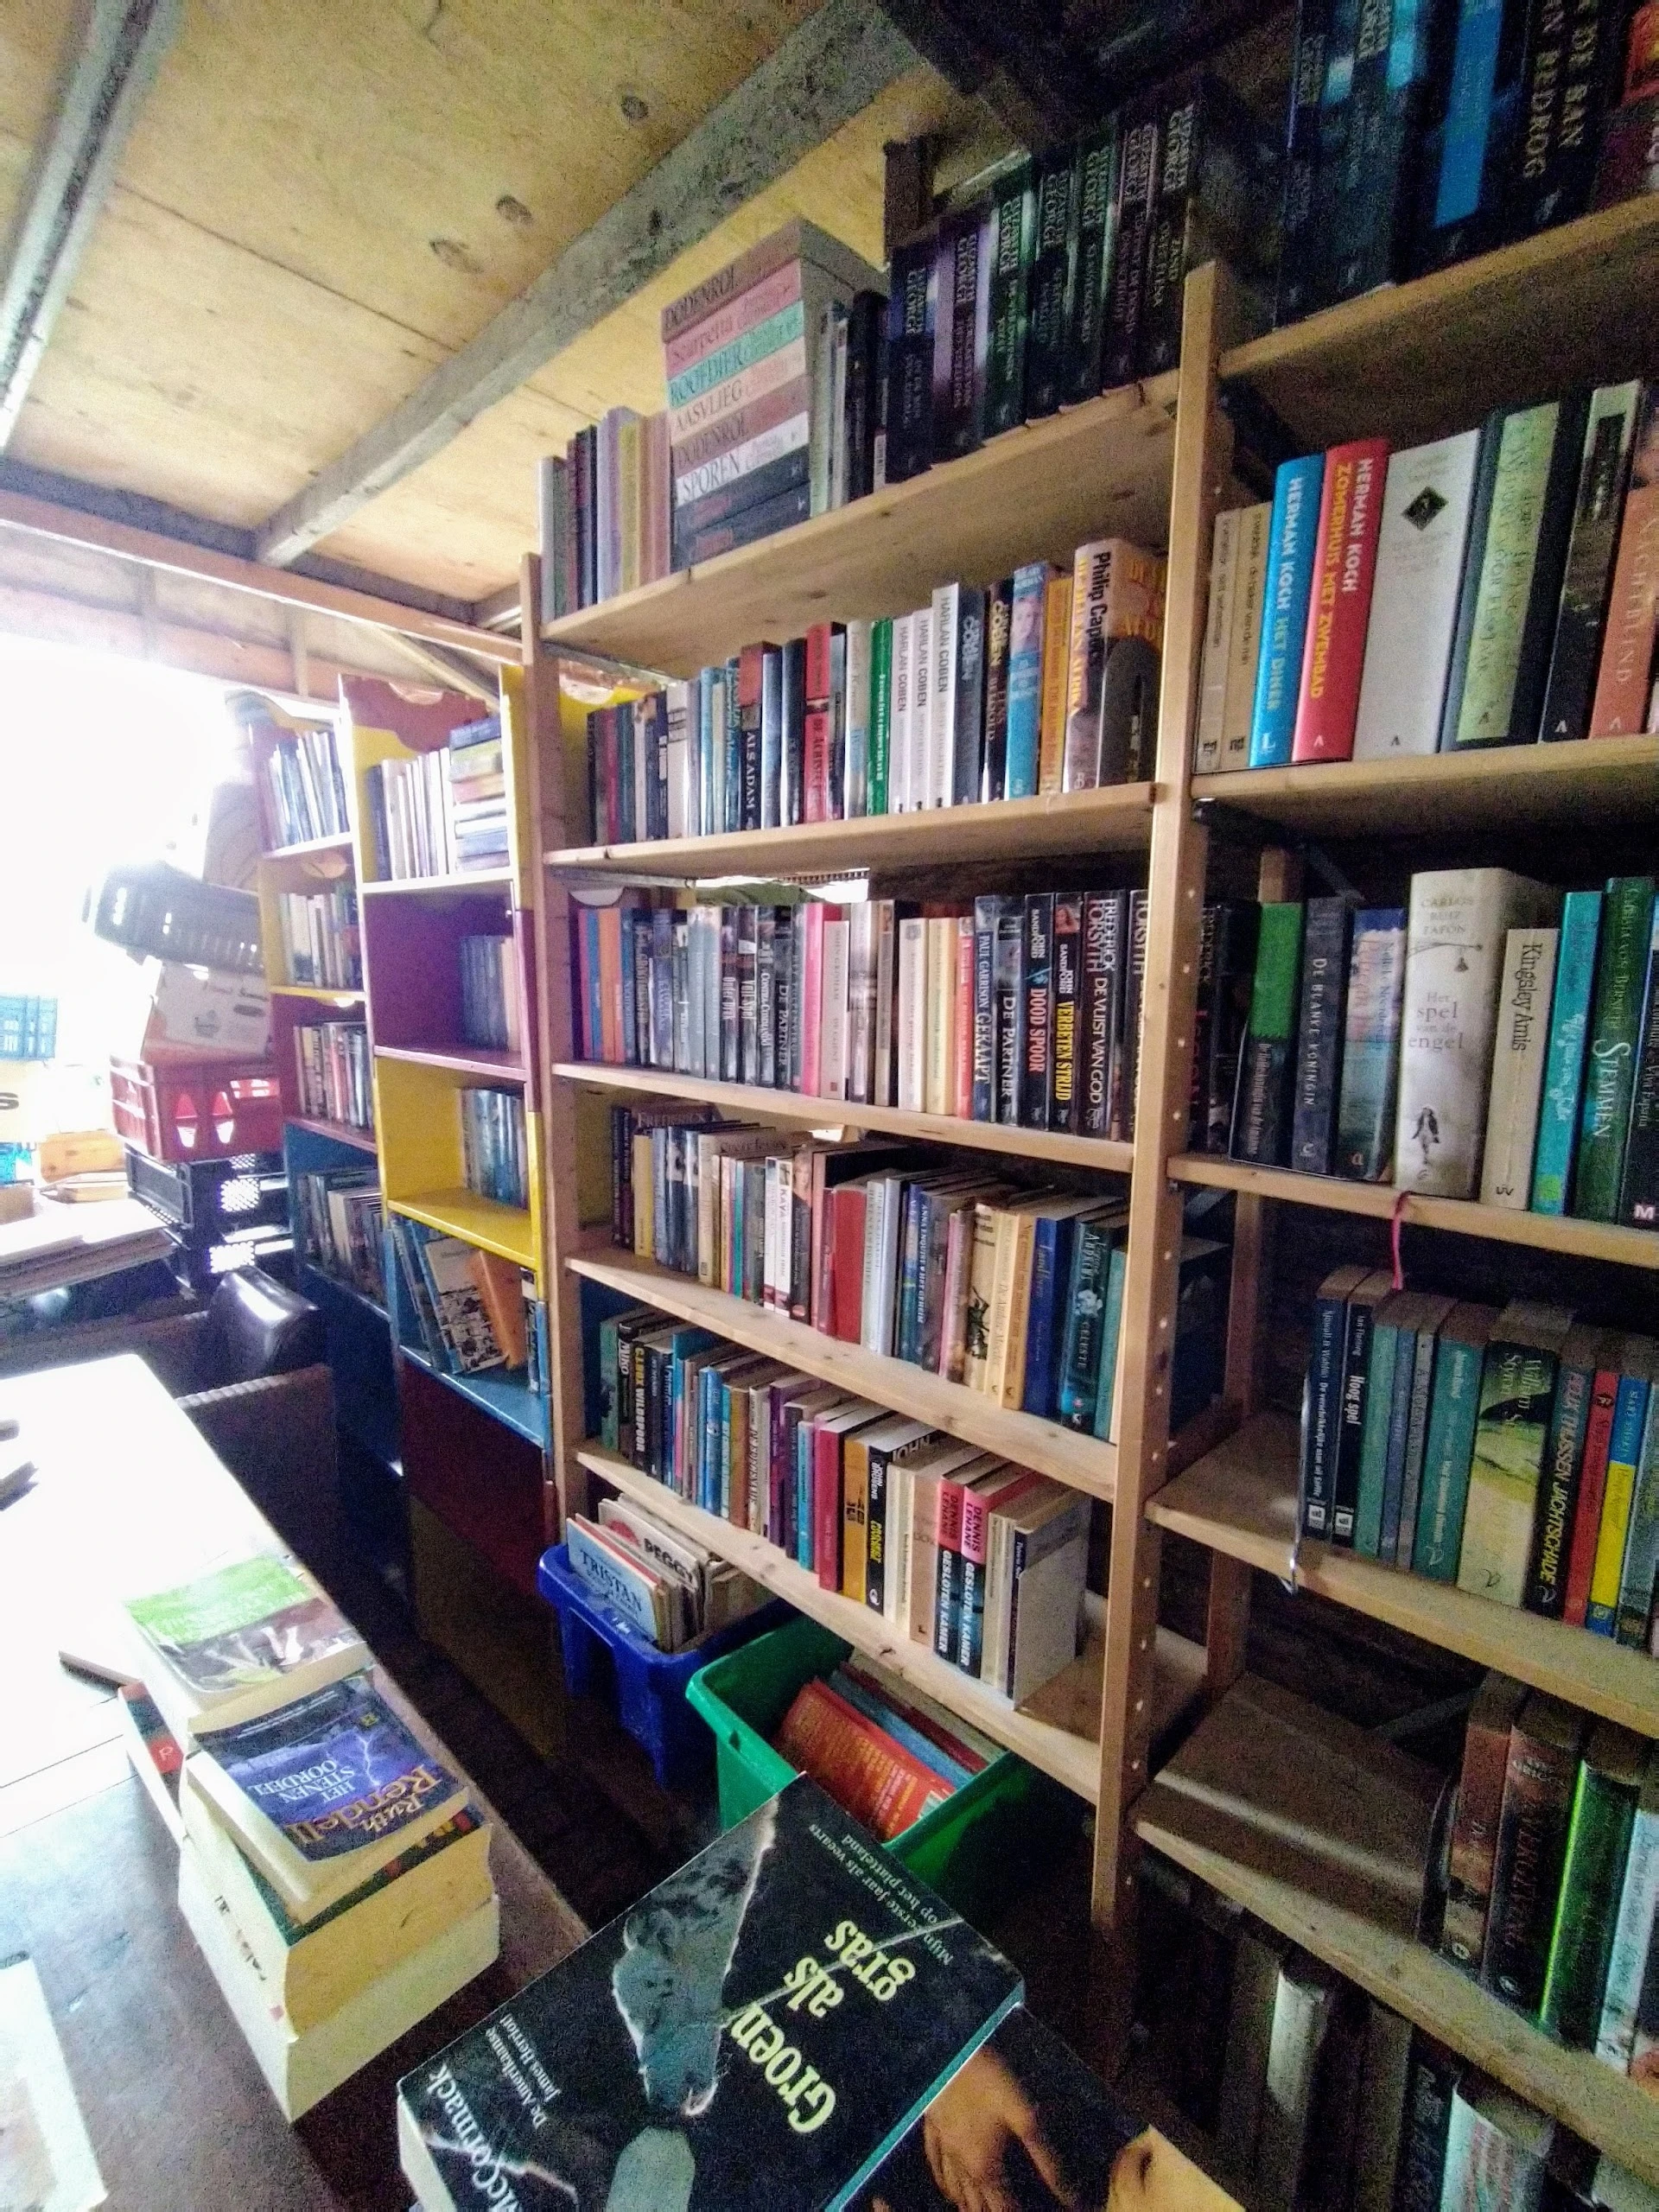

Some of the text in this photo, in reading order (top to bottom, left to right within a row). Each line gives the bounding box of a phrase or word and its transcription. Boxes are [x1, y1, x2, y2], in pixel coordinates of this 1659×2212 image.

[906, 271, 917, 336] GEORGE
[681, 451, 741, 503] SPOREN
[1342, 458, 1373, 592] HERMAN KOCH
[1088, 551, 1111, 602] Philip
[1268, 477, 1303, 710] HERMAN KOCH HET DINER
[1310, 464, 1351, 699] ZOMERHUIS MET ZWEMBAD
[899, 626, 909, 671] HARLAN
[918, 619, 929, 665] HARLAN
[938, 596, 951, 646] HARLAN
[898, 673, 908, 713] COBEN
[917, 667, 927, 708] COBEN
[938, 649, 949, 693] COBEN
[746, 764, 755, 810] ADAM
[1037, 933, 1046, 959] JOHN
[1102, 899, 1118, 971] FREDERICK
[832, 957, 841, 1001] GRISHAM
[975, 934, 993, 1085] PAUL GARRISON GEKAAPT
[1028, 908, 1046, 1072] SANDFORD DOOD SPOOR
[1085, 899, 1107, 1104] FORSYTH DE VUIST VAN GOD
[1511, 943, 1544, 1052] Kingsley Amis
[778, 983, 790, 1068] DE PARTNER
[1054, 944, 1075, 1101] SANDFORD VERBETEN STRIJD
[1303, 957, 1328, 1106] DE BLANKE KONINGIN
[1407, 1032, 1464, 1054] engel
[1416, 1001, 1459, 1023] spel
[1001, 995, 1017, 1098] DE PARTNER
[1591, 1038, 1632, 1138] STEMMEN
[918, 1228, 927, 1264] ENQUIST
[920, 1204, 929, 1227] ANNA
[1356, 1315, 1366, 1327] Ian
[1343, 1402, 1363, 1426] spel
[1344, 1374, 1366, 1402] Hoog
[635, 1389, 645, 1452] WILDSPOOR
[1554, 1414, 1579, 1483] THIJSSEN
[941, 1491, 950, 1535] LEHANE
[963, 1502, 973, 1550] LEHANE
[971, 1506, 982, 1553] DENNIS
[1540, 1481, 1568, 1586] JACHTSCHADE
[938, 1549, 952, 1653] GESLOTEN KAMER
[960, 1562, 975, 1667] GESLOTEN KAMER
[248, 1759, 339, 1796] OORDEEL
[278, 1765, 356, 1803] STENEN
[283, 1764, 442, 1846] Rendell
[321, 1780, 357, 1803] HET
[359, 1793, 425, 1833] Ruth
[808, 1822, 955, 1967] Mijn eerste jaar als veearts
[841, 1834, 939, 1925] op het platteland
[783, 1956, 845, 2018] als
[823, 1919, 916, 2002] gras
[485, 2025, 550, 2130] De Amerikaanse
[528, 2060, 563, 2103] James
[729, 2001, 836, 2134] Groen
[426, 2062, 524, 2212] McCormack
